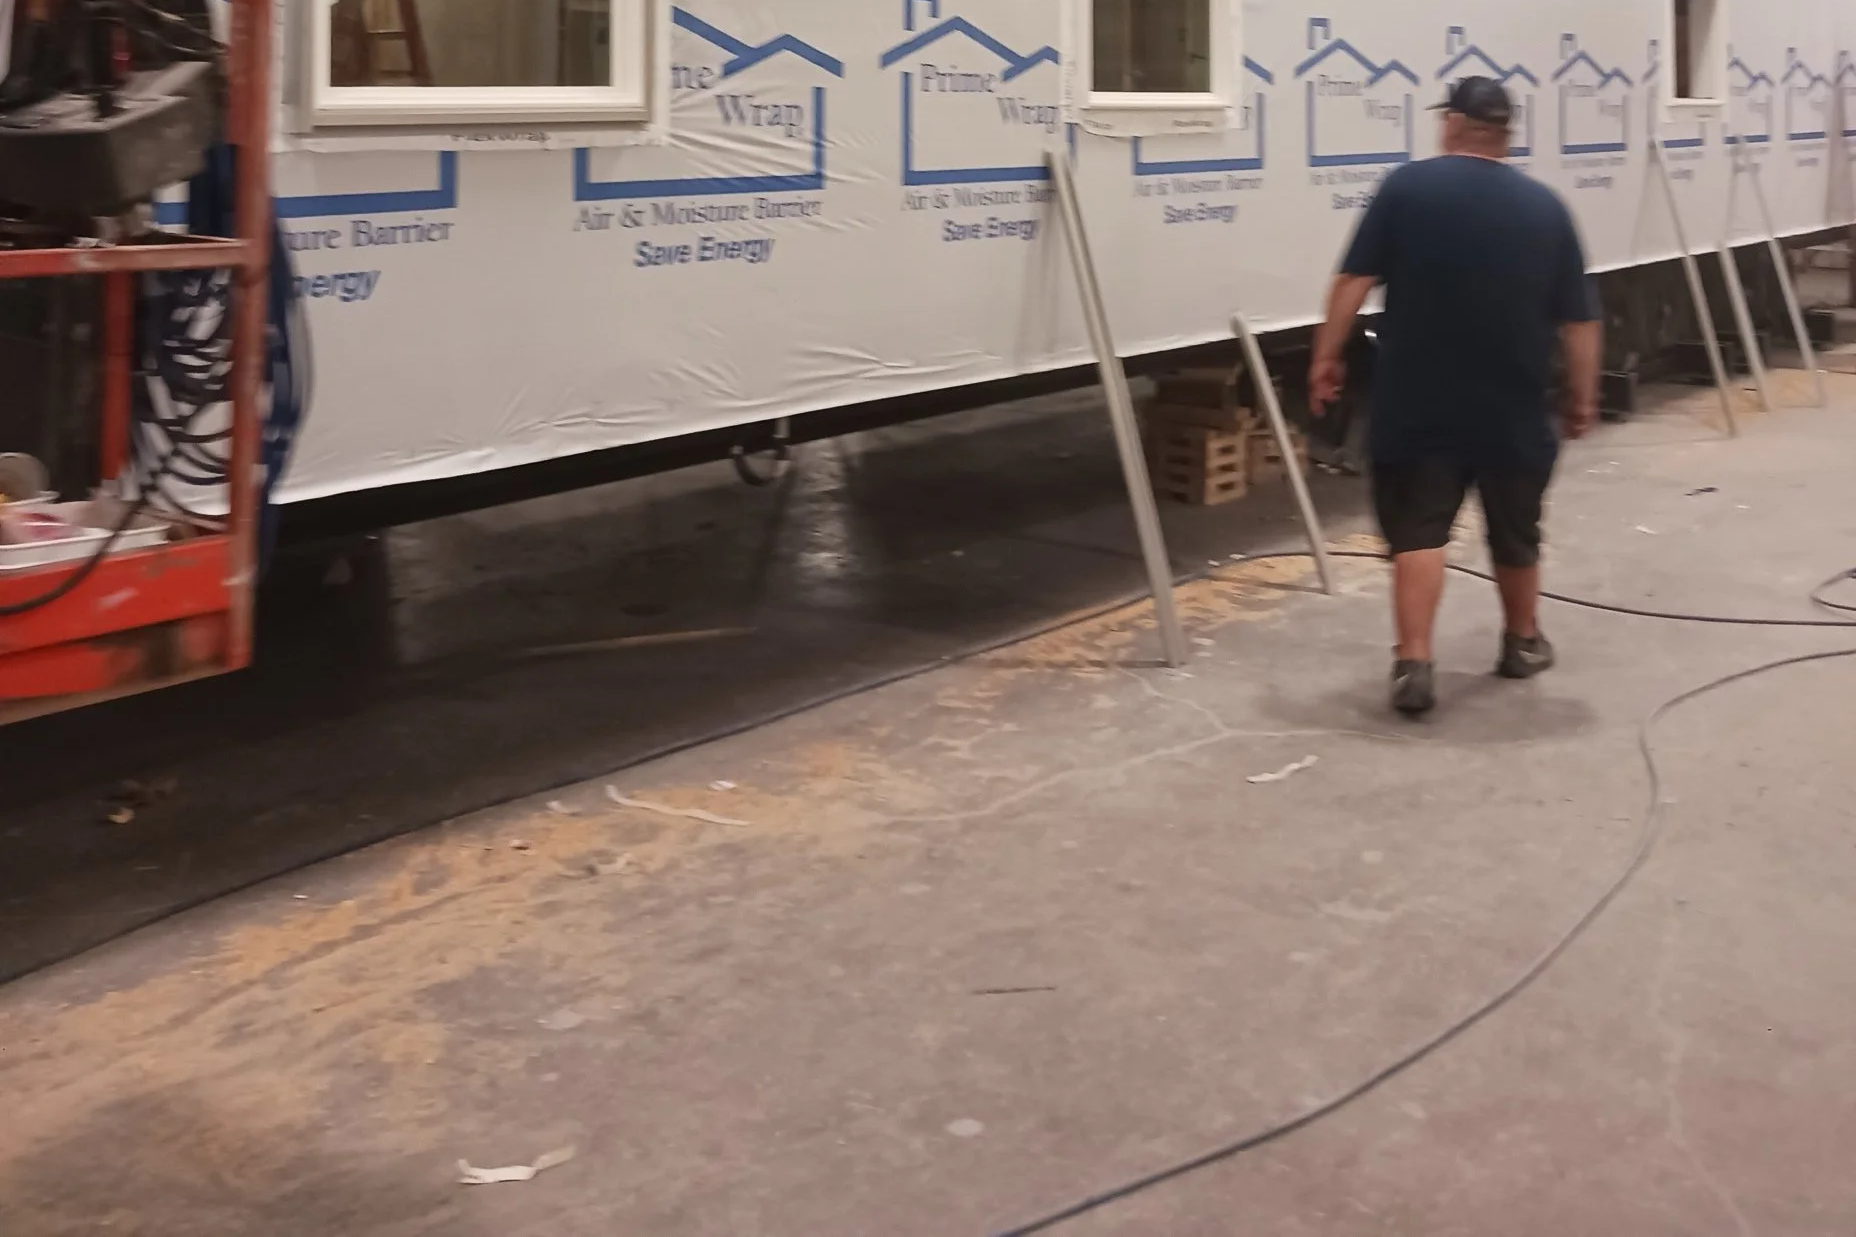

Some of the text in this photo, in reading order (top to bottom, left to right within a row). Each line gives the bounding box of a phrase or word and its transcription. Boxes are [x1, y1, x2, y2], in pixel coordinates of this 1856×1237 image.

[919, 62, 998, 93] Prime
[715, 94, 805, 138] Wrap
[572, 203, 615, 232] Air
[649, 200, 750, 226] Moisture
[754, 196, 824, 220] Barrier
[350, 216, 455, 248] Barrier
[633, 236, 777, 268] Save Energy
[290, 270, 382, 302] nergy
